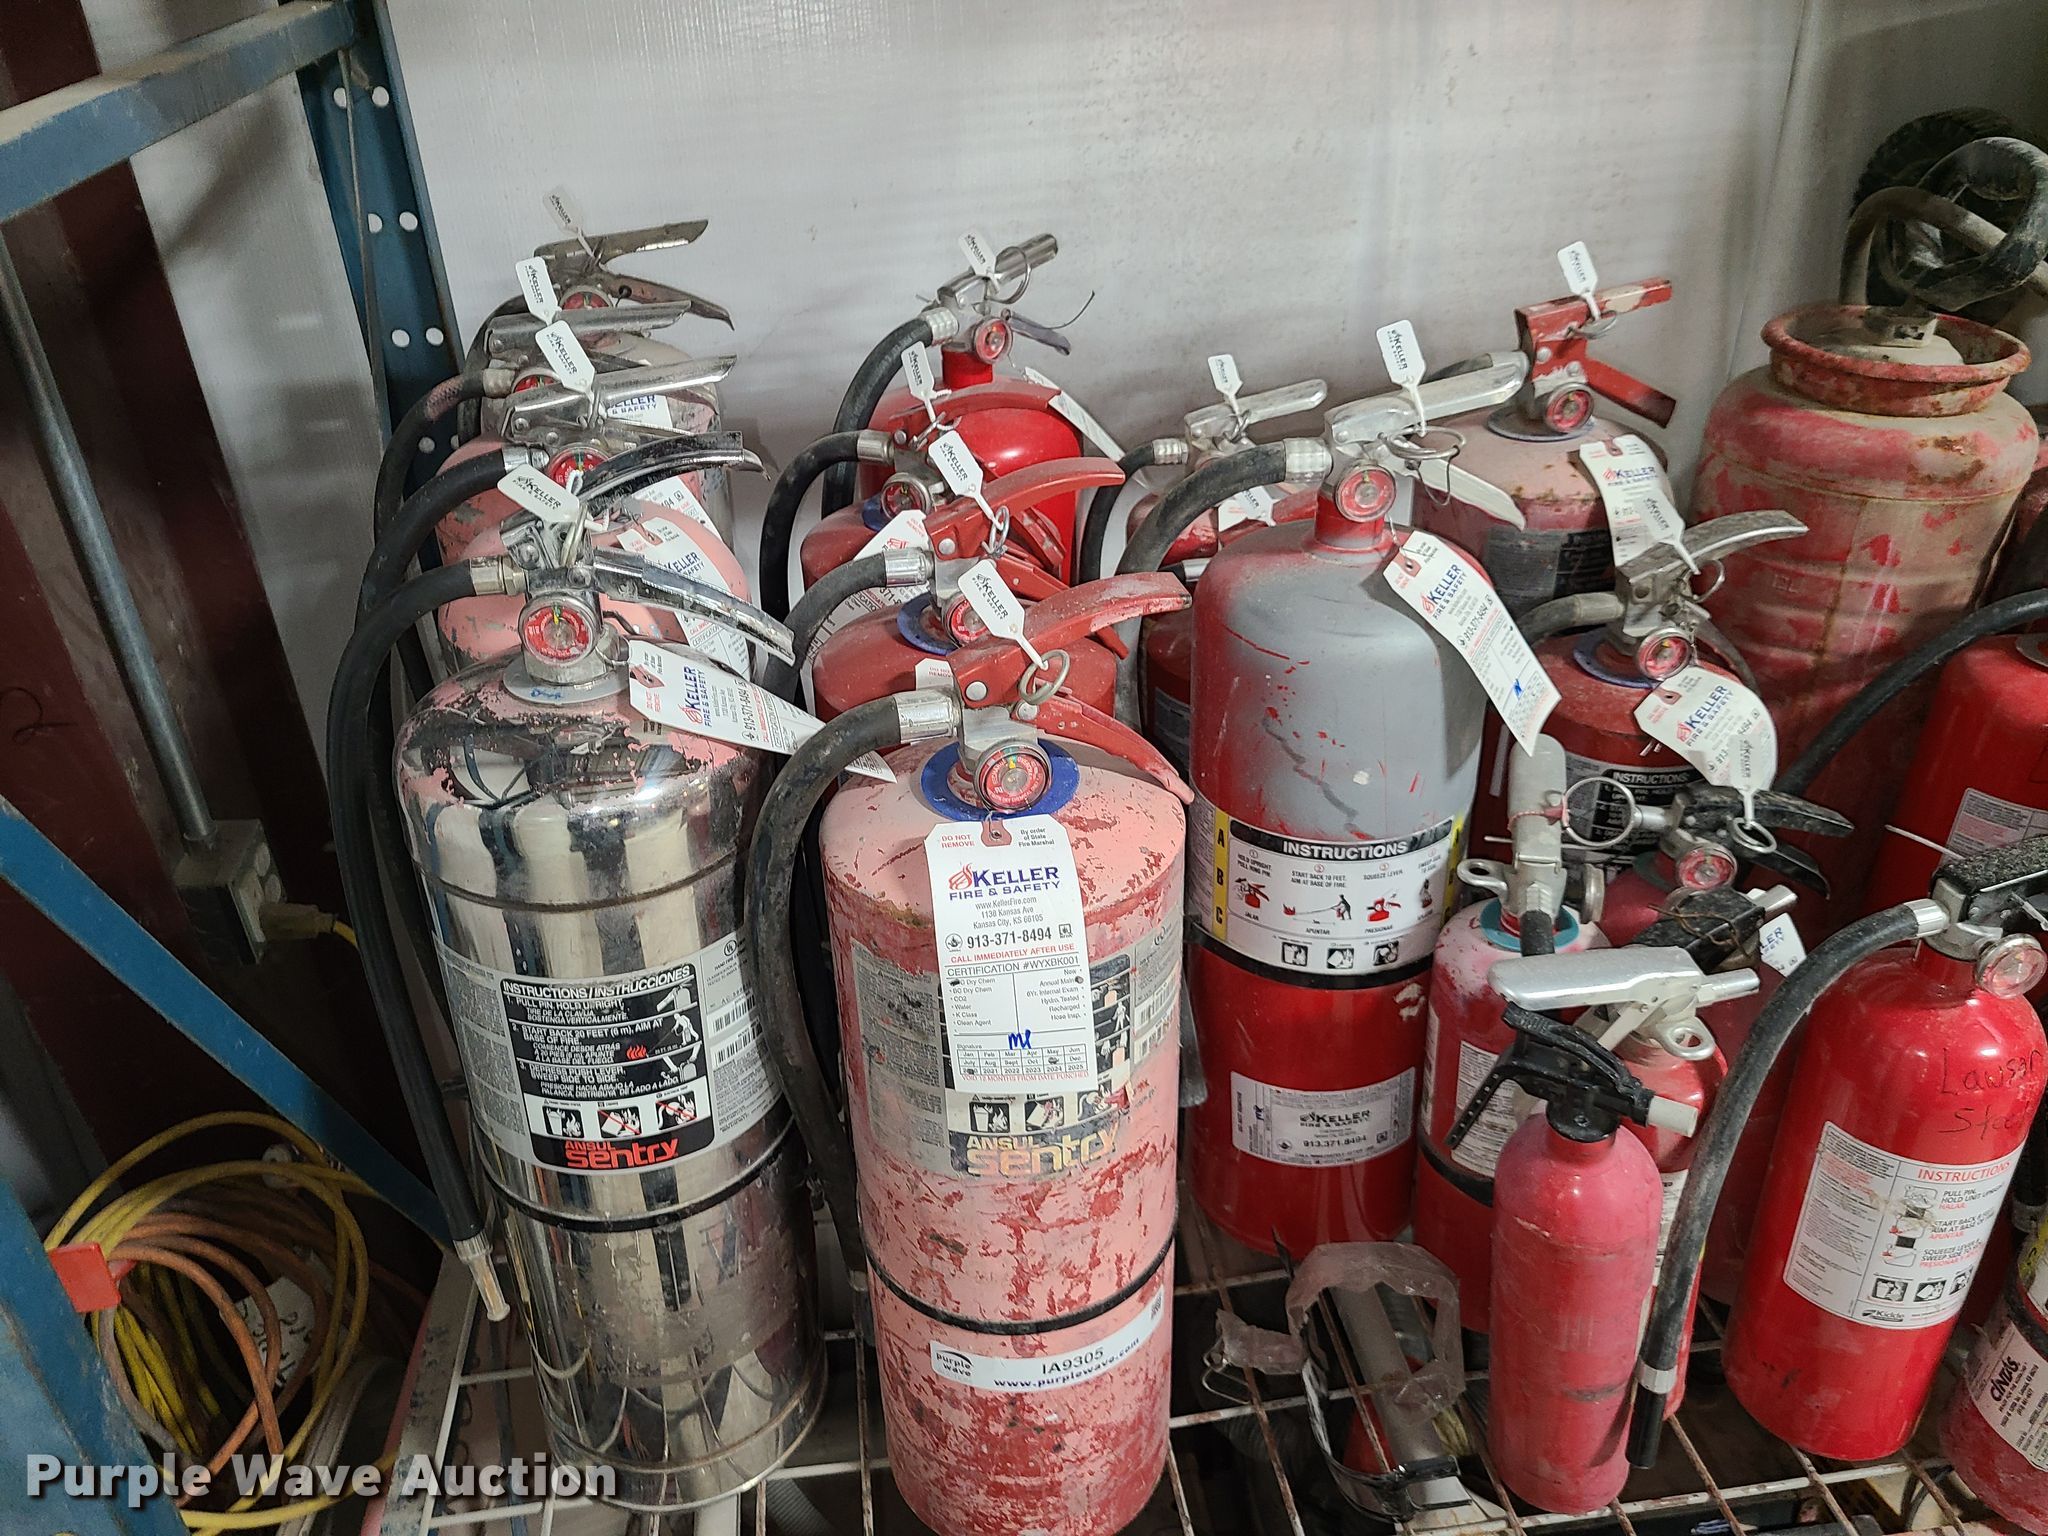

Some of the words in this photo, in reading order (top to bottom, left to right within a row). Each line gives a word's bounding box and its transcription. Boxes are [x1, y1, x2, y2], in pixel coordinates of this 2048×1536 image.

[531, 273, 543, 304] KELLER
[556, 339, 577, 374] KELLER
[1393, 336, 1408, 369] KELLER
[620, 404, 657, 413] SAFETY
[949, 451, 969, 480] KELLER
[1616, 467, 1655, 478] KELLER
[527, 482, 561, 507] KELLER
[1428, 564, 1462, 606] KELLER
[983, 582, 1009, 618] KELLER
[1433, 605, 1446, 621] FIRE
[1448, 573, 1468, 597] SAFETY
[684, 666, 702, 711] KELLER
[697, 669, 708, 700] SAFETY
[1685, 685, 1727, 729] KELLER
[1710, 690, 1733, 720] SAFETY
[703, 709, 712, 727] FIRE
[1613, 772, 1688, 785] INSTRUCTIONS
[942, 841, 975, 849] REMOVE
[1217, 828, 1225, 848] A
[1283, 840, 1409, 860] INSTRUCTIONS
[973, 866, 1060, 888] KELLER
[1216, 869, 1224, 886] B
[950, 888, 983, 901] FIRE
[989, 887, 998, 896] &
[1003, 881, 1061, 895] SAFETY
[975, 897, 1037, 910] www.KellerFire.com
[998, 908, 1021, 917] Kansas
[1022, 906, 1034, 914] Ave
[973, 920, 996, 930] Kansas
[997, 919, 1012, 928] City,
[1013, 917, 1022, 925] KS
[1215, 906, 1223, 925] C
[967, 927, 1052, 949] 913-371-8494
[951, 956, 972, 964] CALL
[974, 950, 1028, 961] IMMEDIATELY
[1030, 946, 1057, 955] AFTER
[1058, 943, 1075, 952] USE
[947, 963, 1020, 977] CERTIFICATION
[1023, 956, 1079, 970] #WYXBK001
[978, 977, 996, 985] Chem
[516, 997, 538, 1007] PULL
[556, 1001, 581, 1010] HOLD
[1049, 1004, 1081, 1013] Recharged
[521, 1024, 547, 1035] START
[549, 1028, 573, 1038] BACK
[574, 1030, 585, 1039] 20
[586, 1028, 609, 1038] FEET
[635, 1021, 651, 1033] AIM
[652, 1018, 664, 1028] AT
[974, 1019, 992, 1027] Agent
[523, 1033, 546, 1043] BASE
[547, 1036, 559, 1044] OF
[529, 1064, 568, 1075] DEPRESS
[569, 1067, 593, 1076] PUSH
[531, 1072, 560, 1082] SWEEP
[561, 1074, 580, 1083] SIDE
[582, 1075, 594, 1084] TO
[575, 1083, 597, 1092] HACIA
[631, 1084, 651, 1095] LADO
[1316, 1109, 1370, 1123] KELLER
[565, 1141, 618, 1151] ANSUL
[966, 1135, 1035, 1150] ANSUL
[565, 1138, 679, 1169] sentry
[1921, 1253, 1947, 1261] SWEEP
[1924, 1246, 1956, 1255] SQUEEZE
[936, 1351, 972, 1369] purple
[993, 1337, 1140, 1388] www.purplewave.com
[943, 1363, 972, 1377] wave
